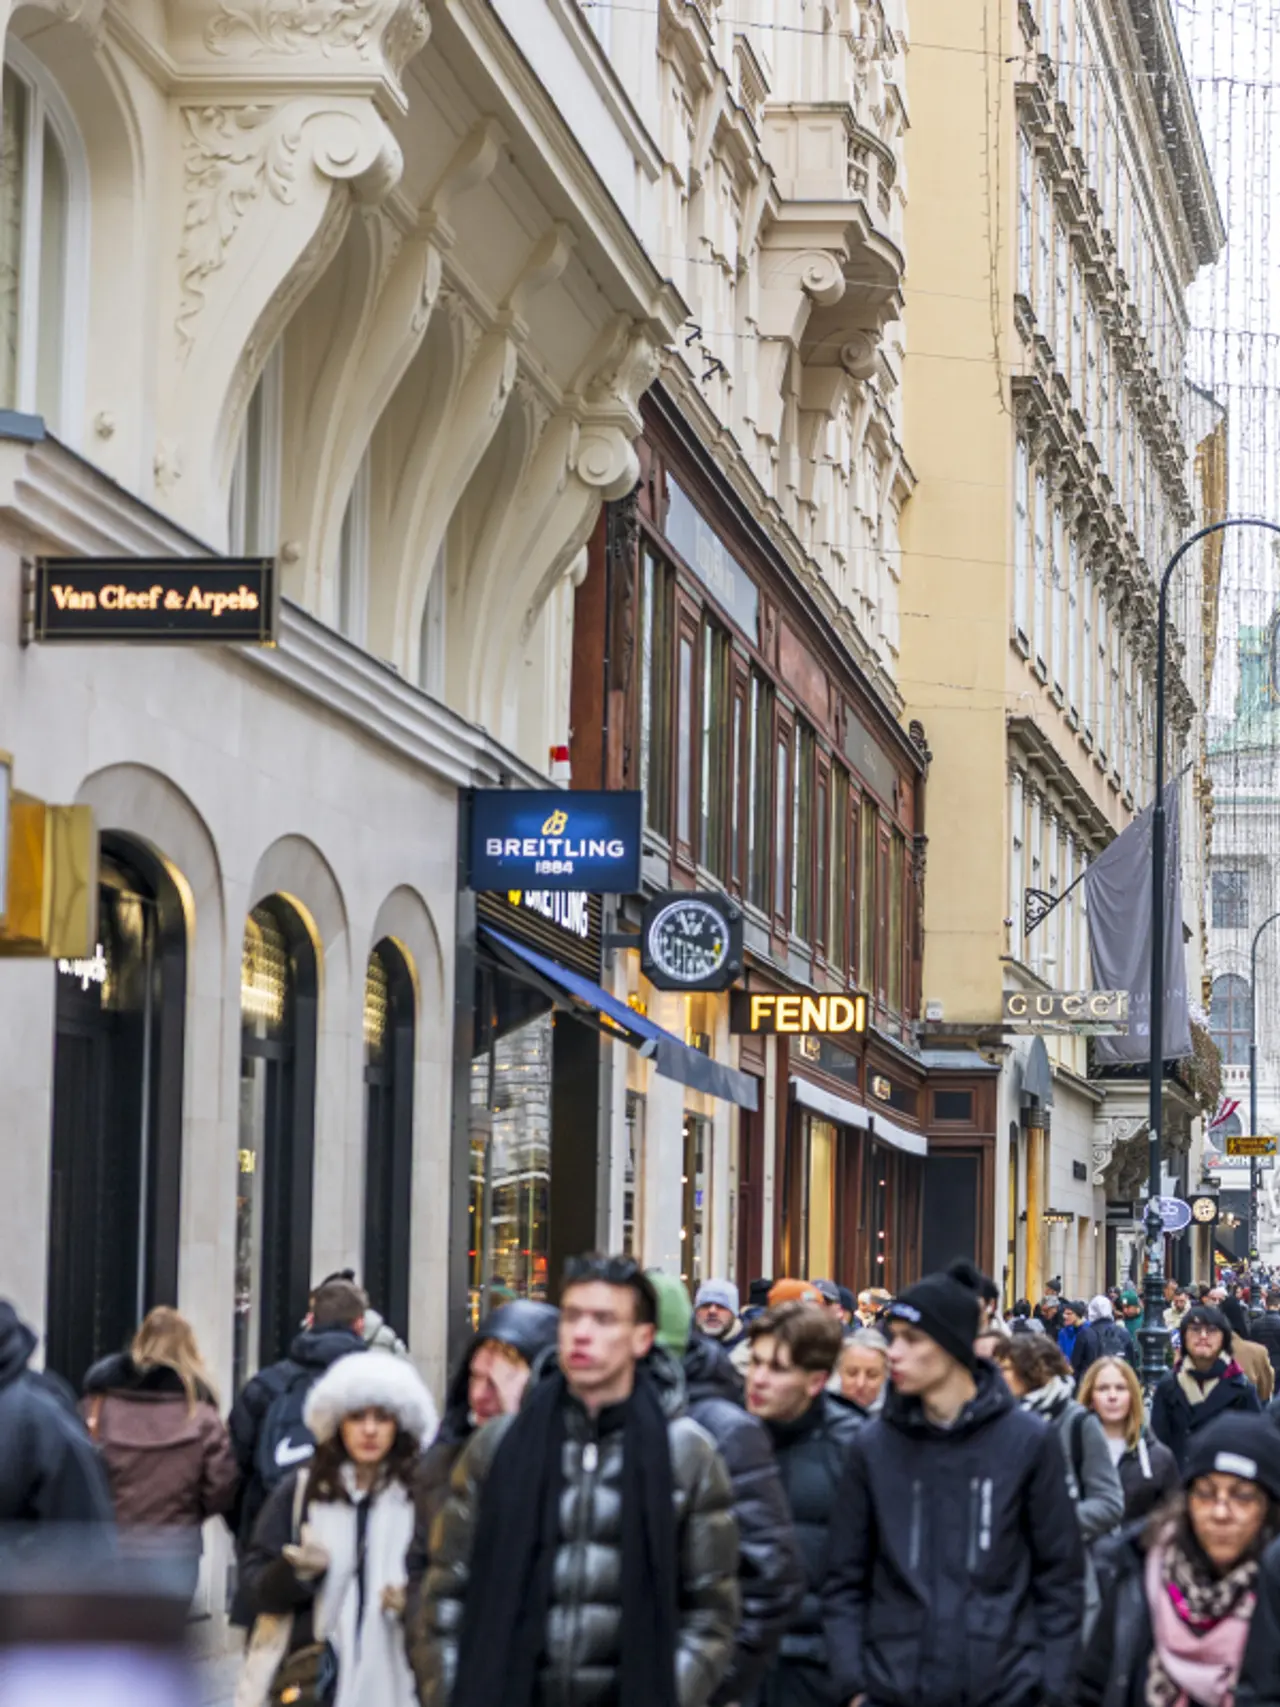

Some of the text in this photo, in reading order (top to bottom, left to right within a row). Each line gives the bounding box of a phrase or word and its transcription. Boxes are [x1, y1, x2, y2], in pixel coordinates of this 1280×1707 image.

[51, 585, 259, 616] Van Cleef & Arpels
[486, 838, 625, 858] BREITLING
[535, 860, 573, 874] 1884
[751, 995, 866, 1032] FENDI
[1008, 994, 1122, 1016] GUCCI
